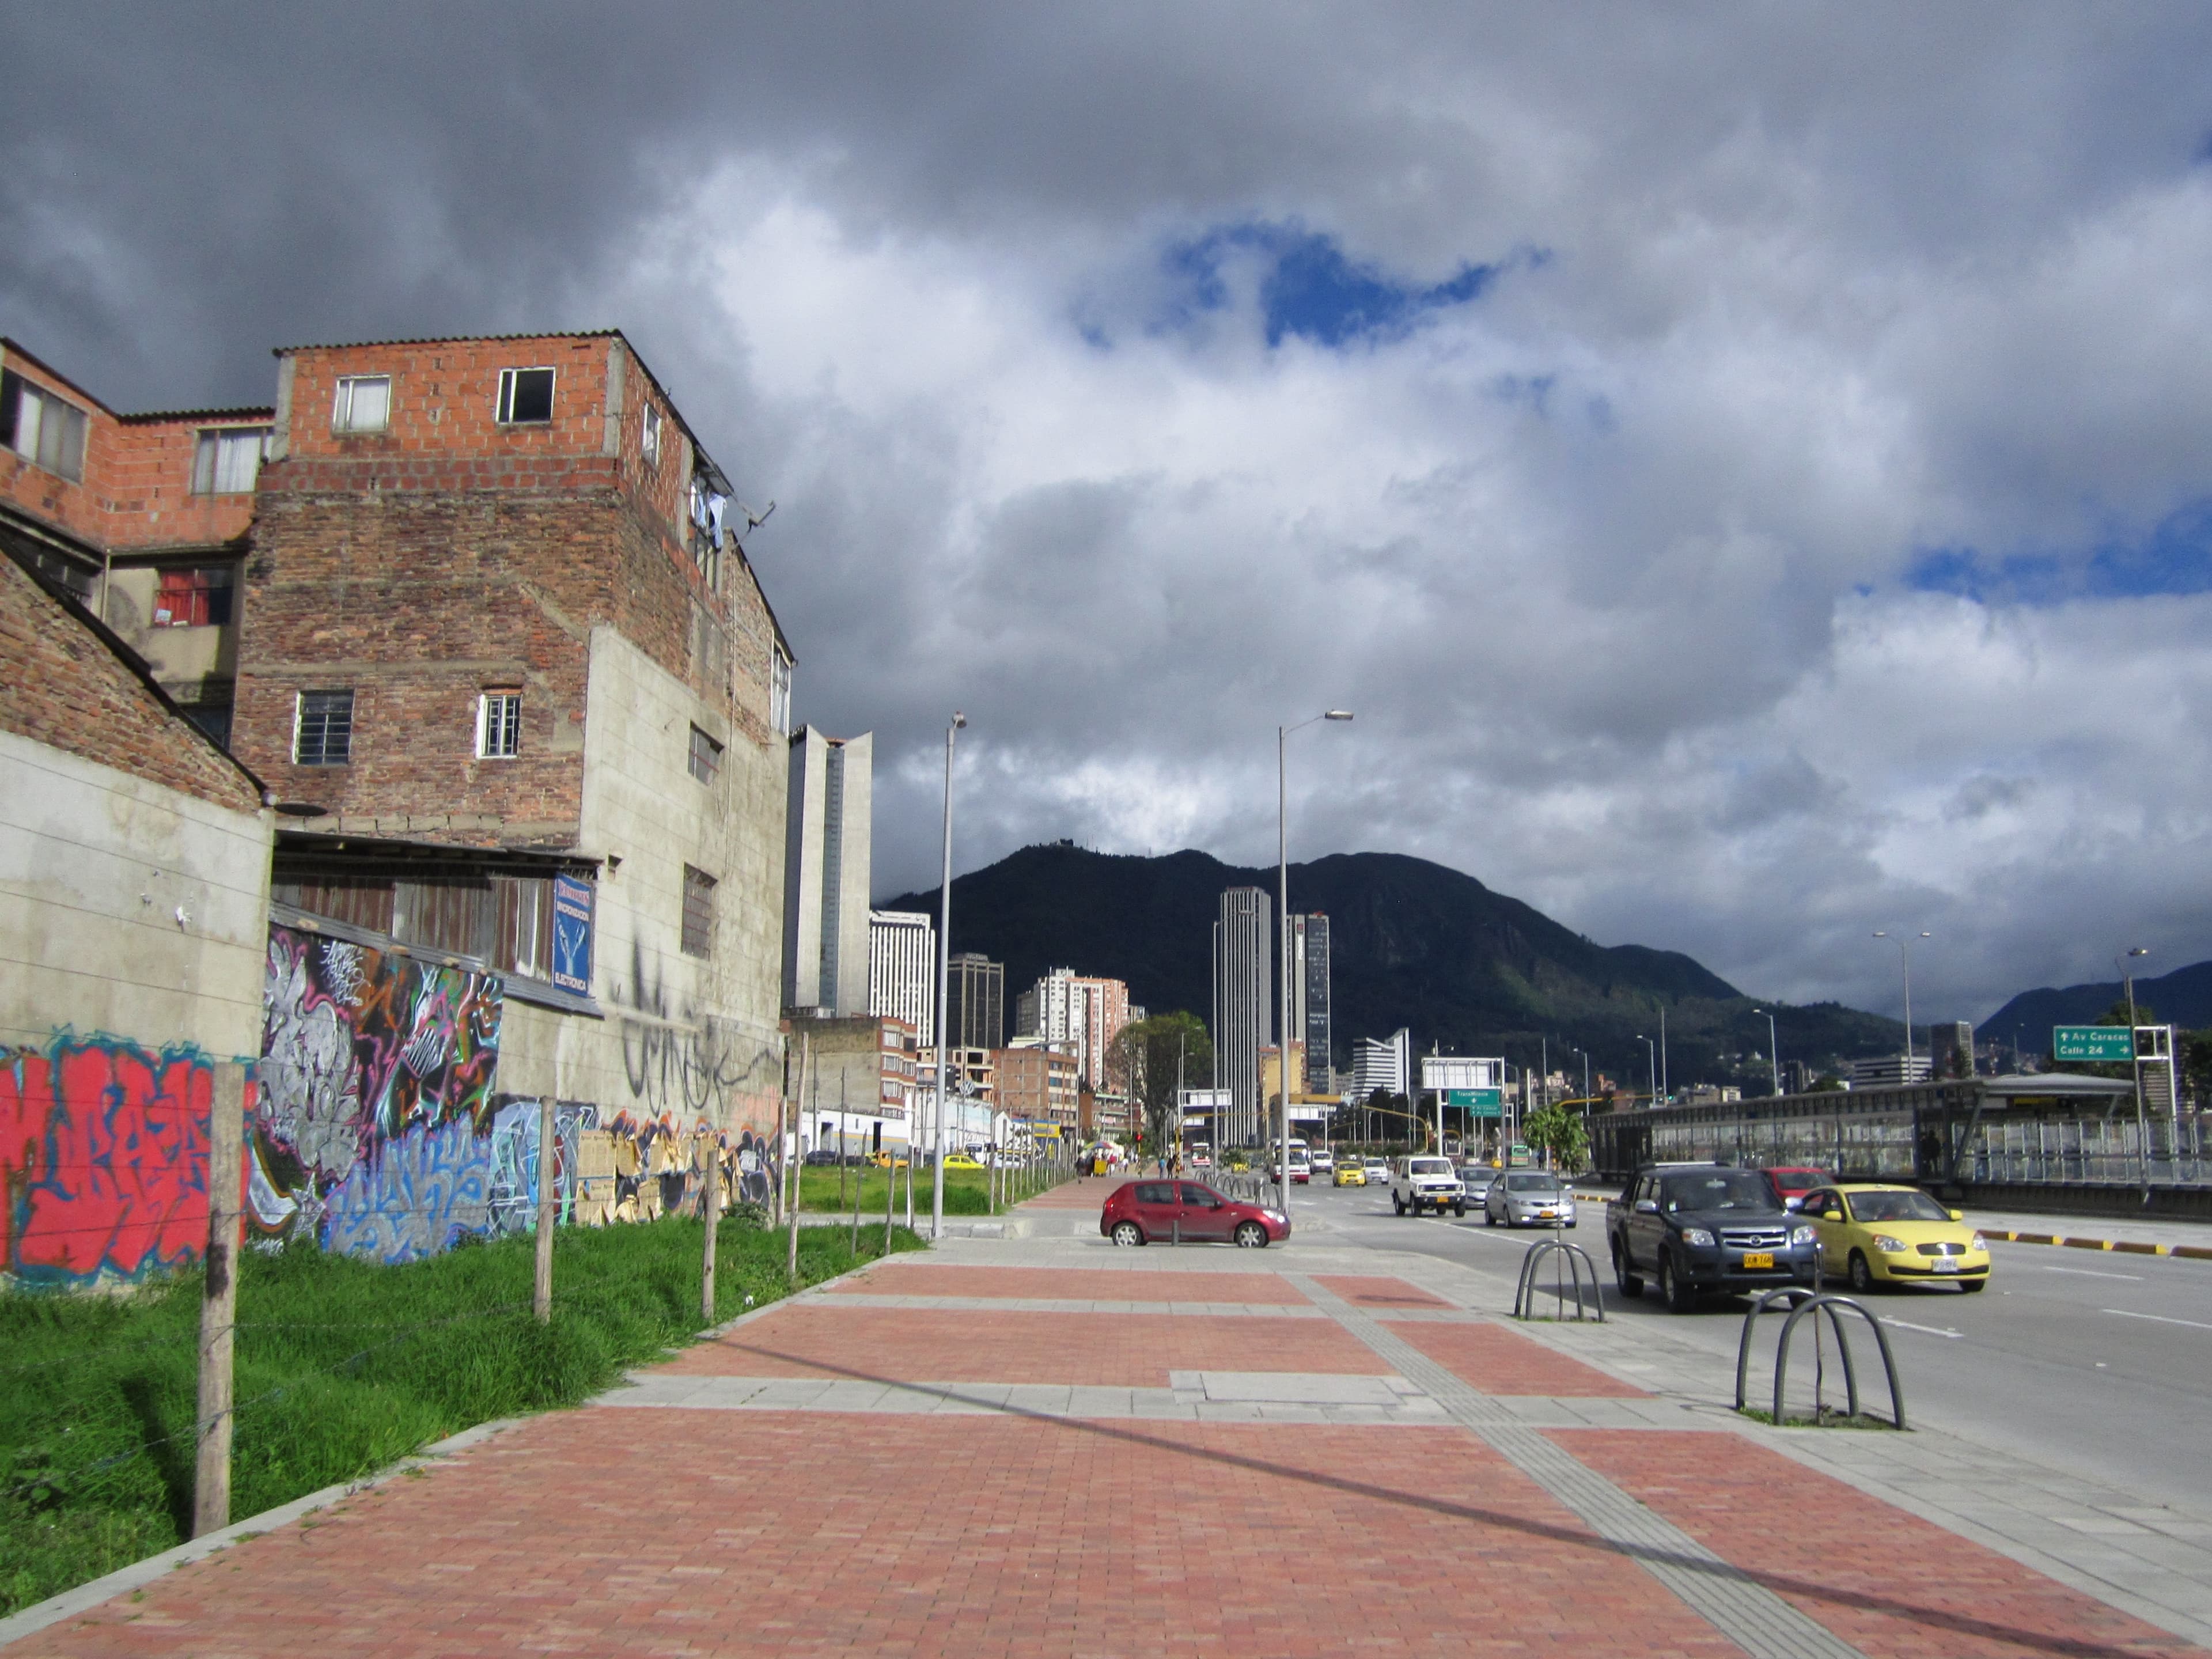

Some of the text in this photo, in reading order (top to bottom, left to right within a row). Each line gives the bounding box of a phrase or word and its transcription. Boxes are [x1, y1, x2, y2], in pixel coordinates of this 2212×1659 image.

[555, 971, 586, 990] ELECTRONICA
[2073, 1032, 2130, 1041] Av Caracas
[2060, 1045, 2104, 1055] Calle 24
